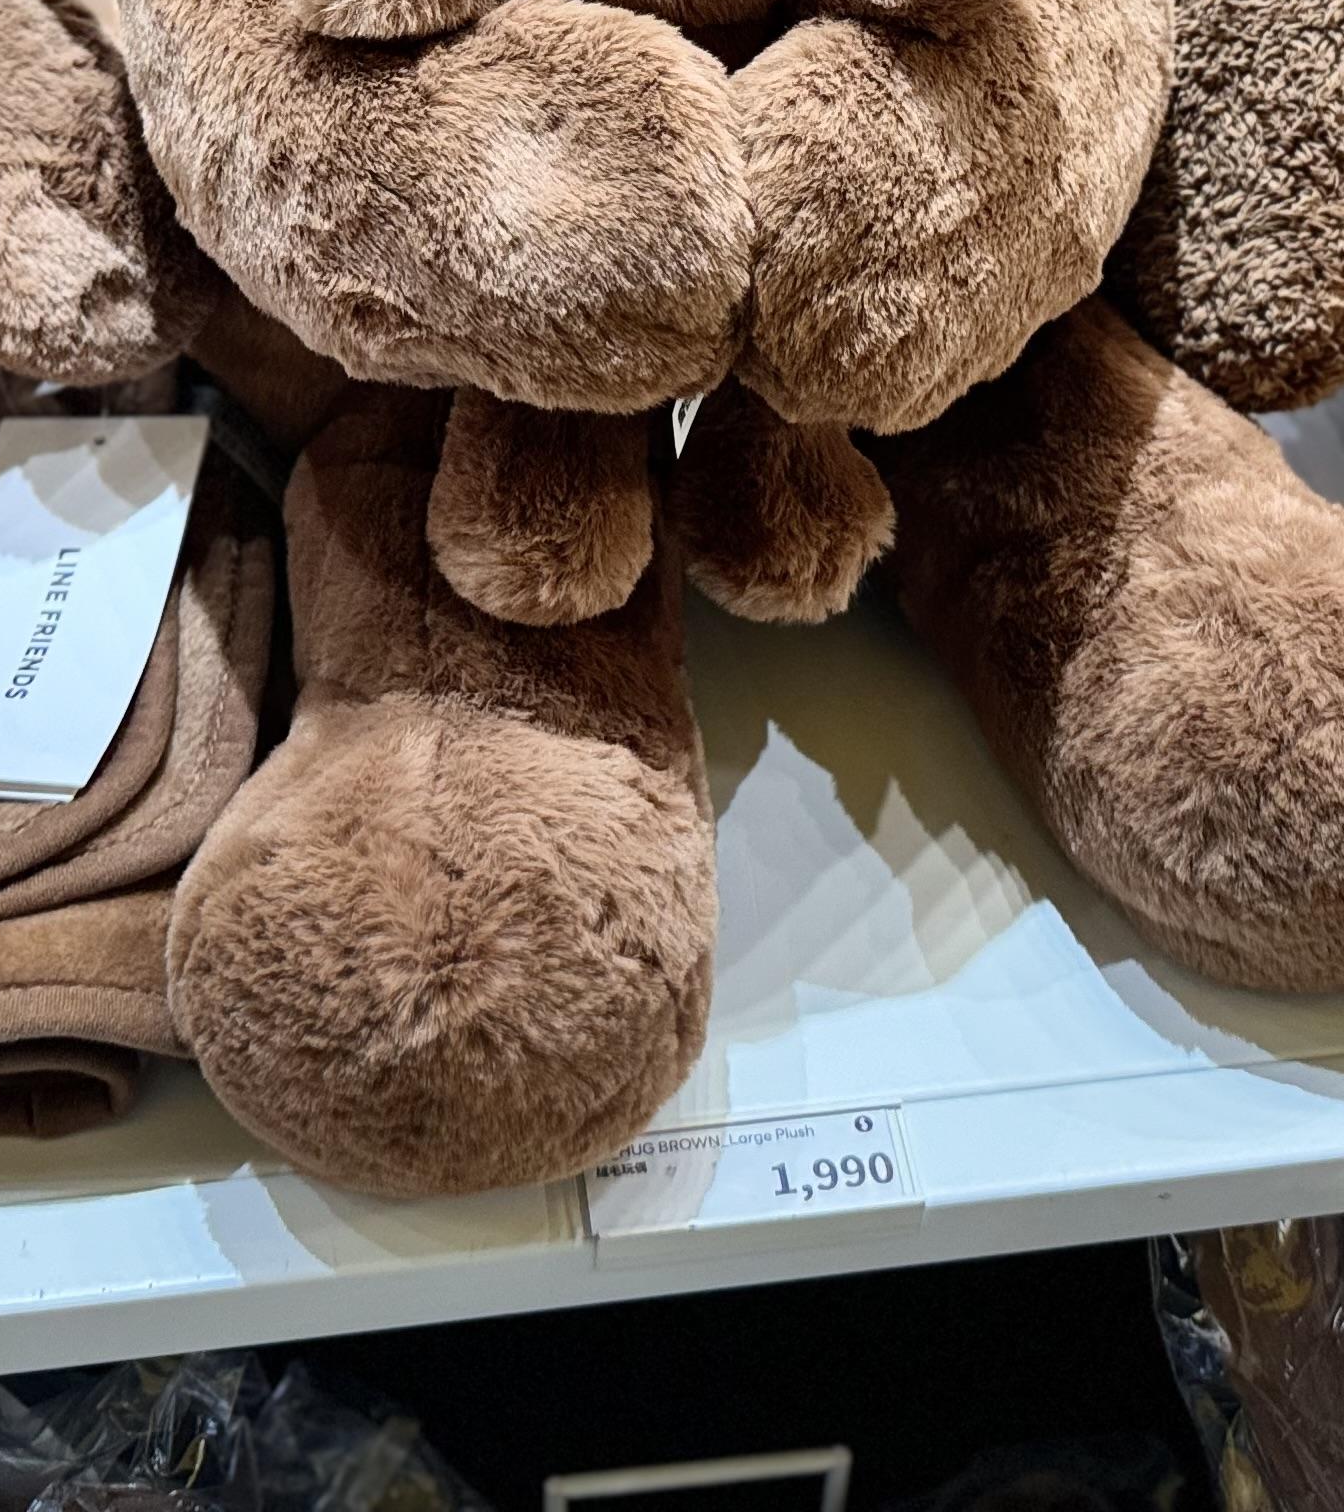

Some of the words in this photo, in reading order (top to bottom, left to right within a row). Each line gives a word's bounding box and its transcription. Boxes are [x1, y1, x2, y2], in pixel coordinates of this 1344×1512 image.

[45, 547, 81, 602] LINE
[5, 610, 61, 700] FRIENDS
[775, 1124, 815, 1141] Plush
[771, 1152, 894, 1201] 1,990
